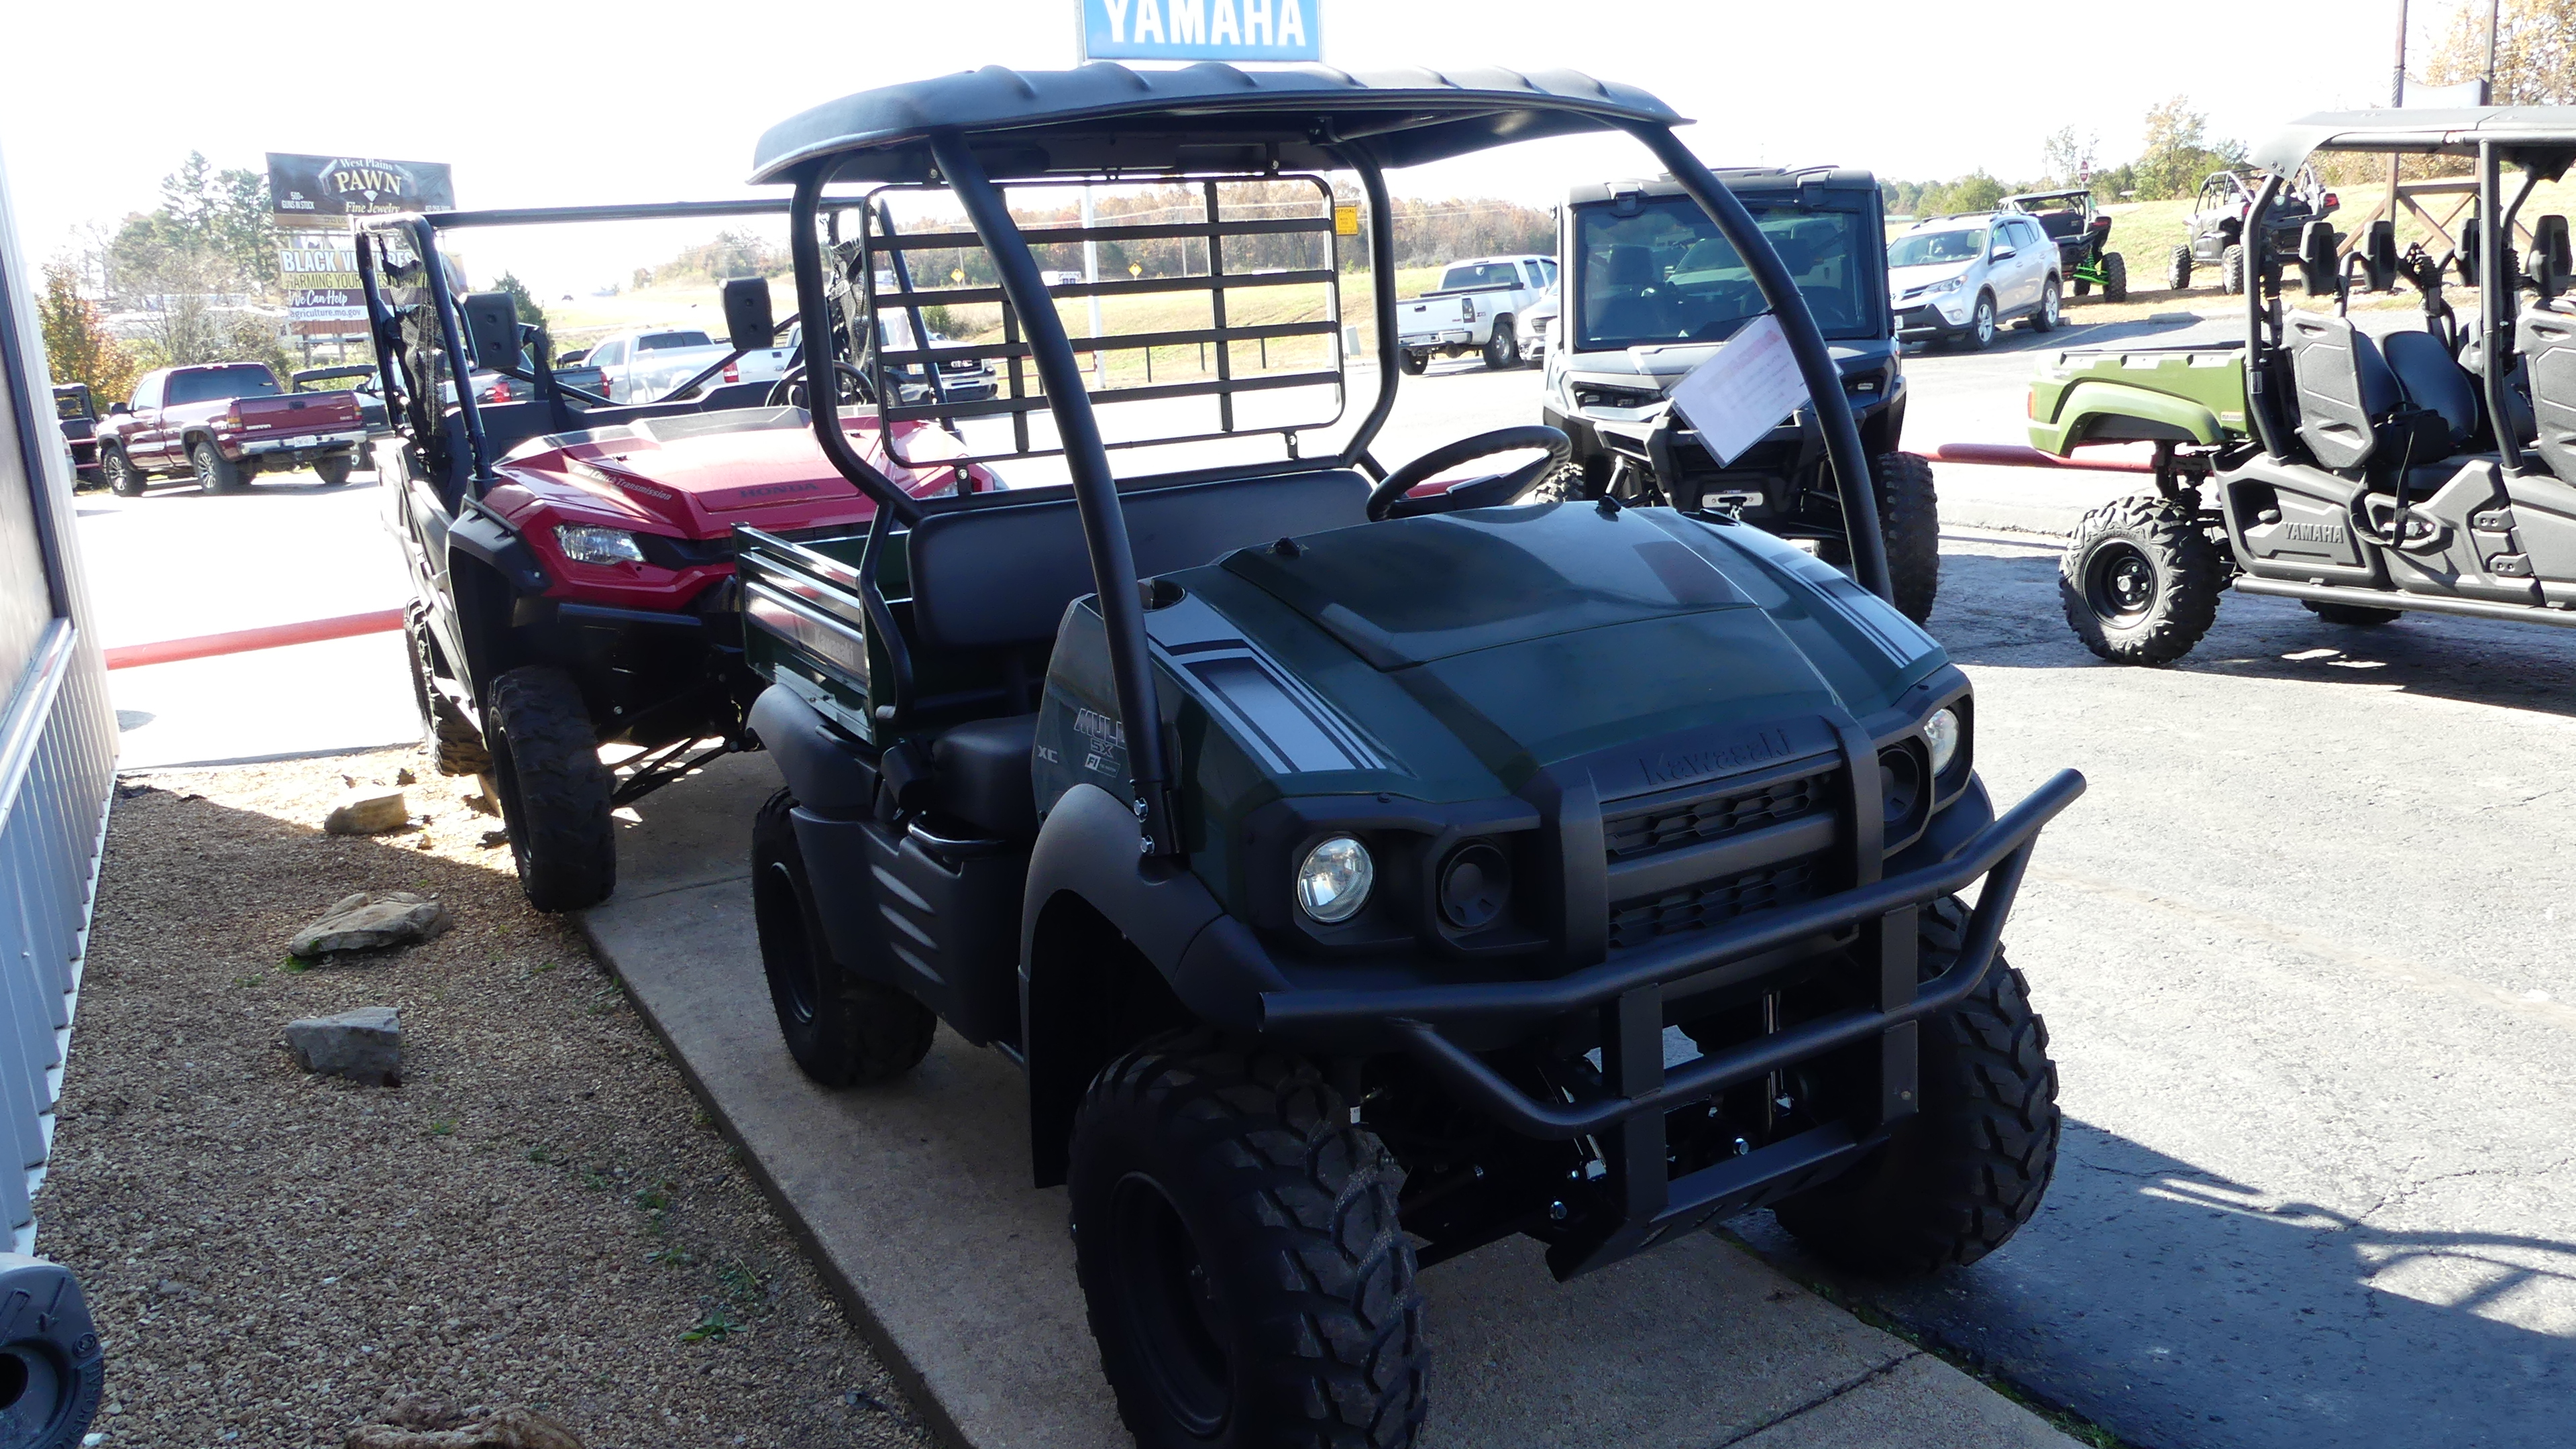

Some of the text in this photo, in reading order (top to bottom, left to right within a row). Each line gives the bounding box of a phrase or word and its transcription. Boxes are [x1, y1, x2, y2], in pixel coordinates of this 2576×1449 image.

[1104, 0, 1306, 46] YAMAHA
[340, 158, 393, 170] West Plains
[334, 169, 402, 196] PAWN
[345, 201, 400, 215] Fine Jewelry
[280, 250, 336, 272] BLACK
[307, 289, 326, 306] Can
[325, 290, 347, 307] Help
[290, 308, 361, 320] agriculture.mo.gov
[591, 471, 617, 484] Clutch
[616, 477, 672, 500] Transmission
[739, 483, 820, 498] HONDA
[2282, 521, 2344, 544] YAMAHA
[814, 627, 854, 666] Kawasaki
[1038, 745, 1058, 764] XC
[1087, 755, 1099, 769] FI
[1638, 728, 1795, 786] Kawasaki
